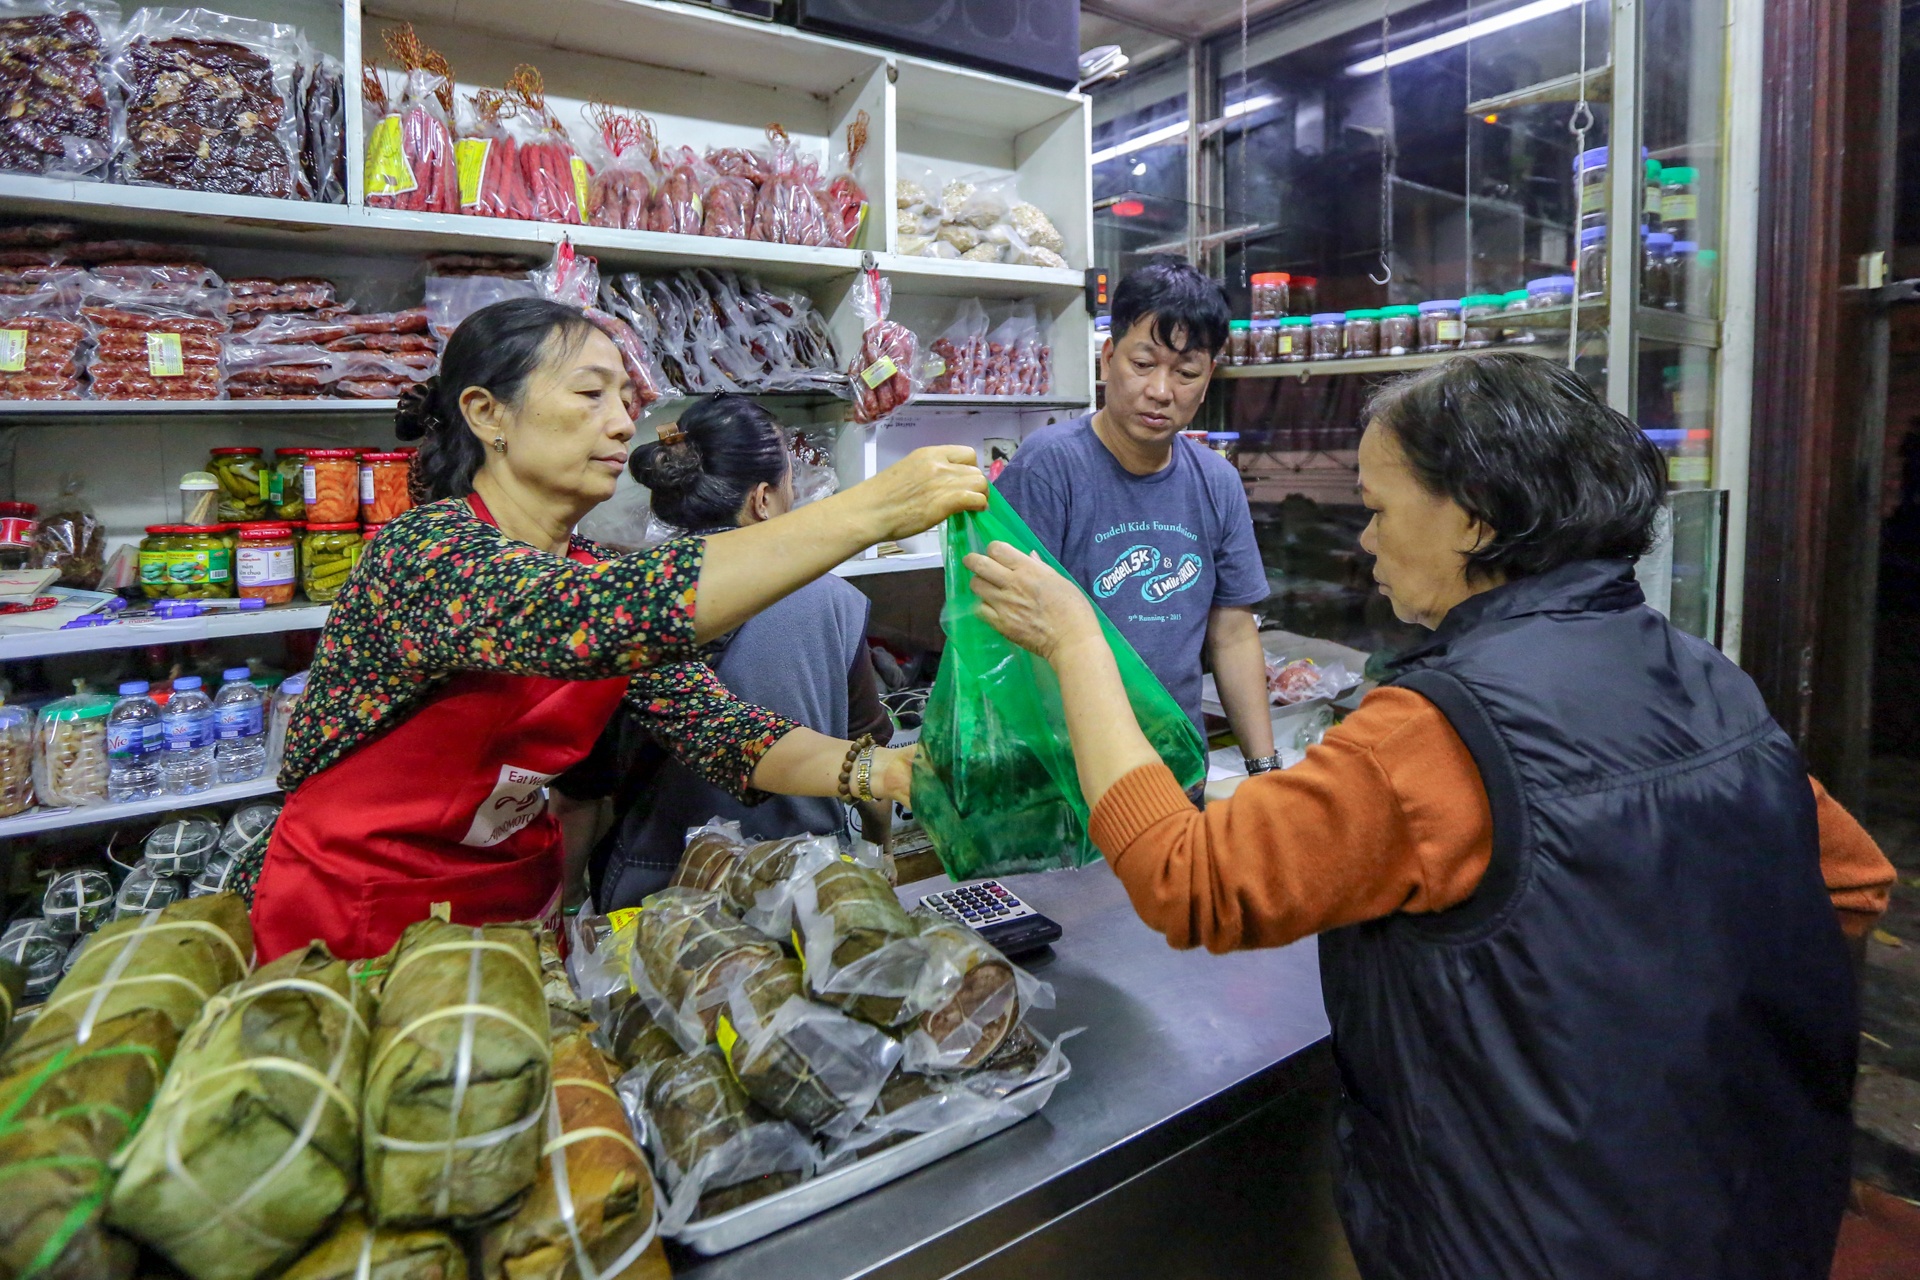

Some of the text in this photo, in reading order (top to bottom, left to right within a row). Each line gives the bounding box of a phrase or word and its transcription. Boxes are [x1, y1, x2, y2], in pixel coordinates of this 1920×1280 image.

[1095, 520, 1198, 543] Oradell Kids Foundaion
[1102, 549, 1151, 591] Oradell 5K
[1163, 556, 1173, 569] &
[1161, 576, 1180, 592] Mile
[1138, 613, 1166, 623] Running
[1170, 613, 1182, 621] 2015
[509, 770, 529, 785] Eat
